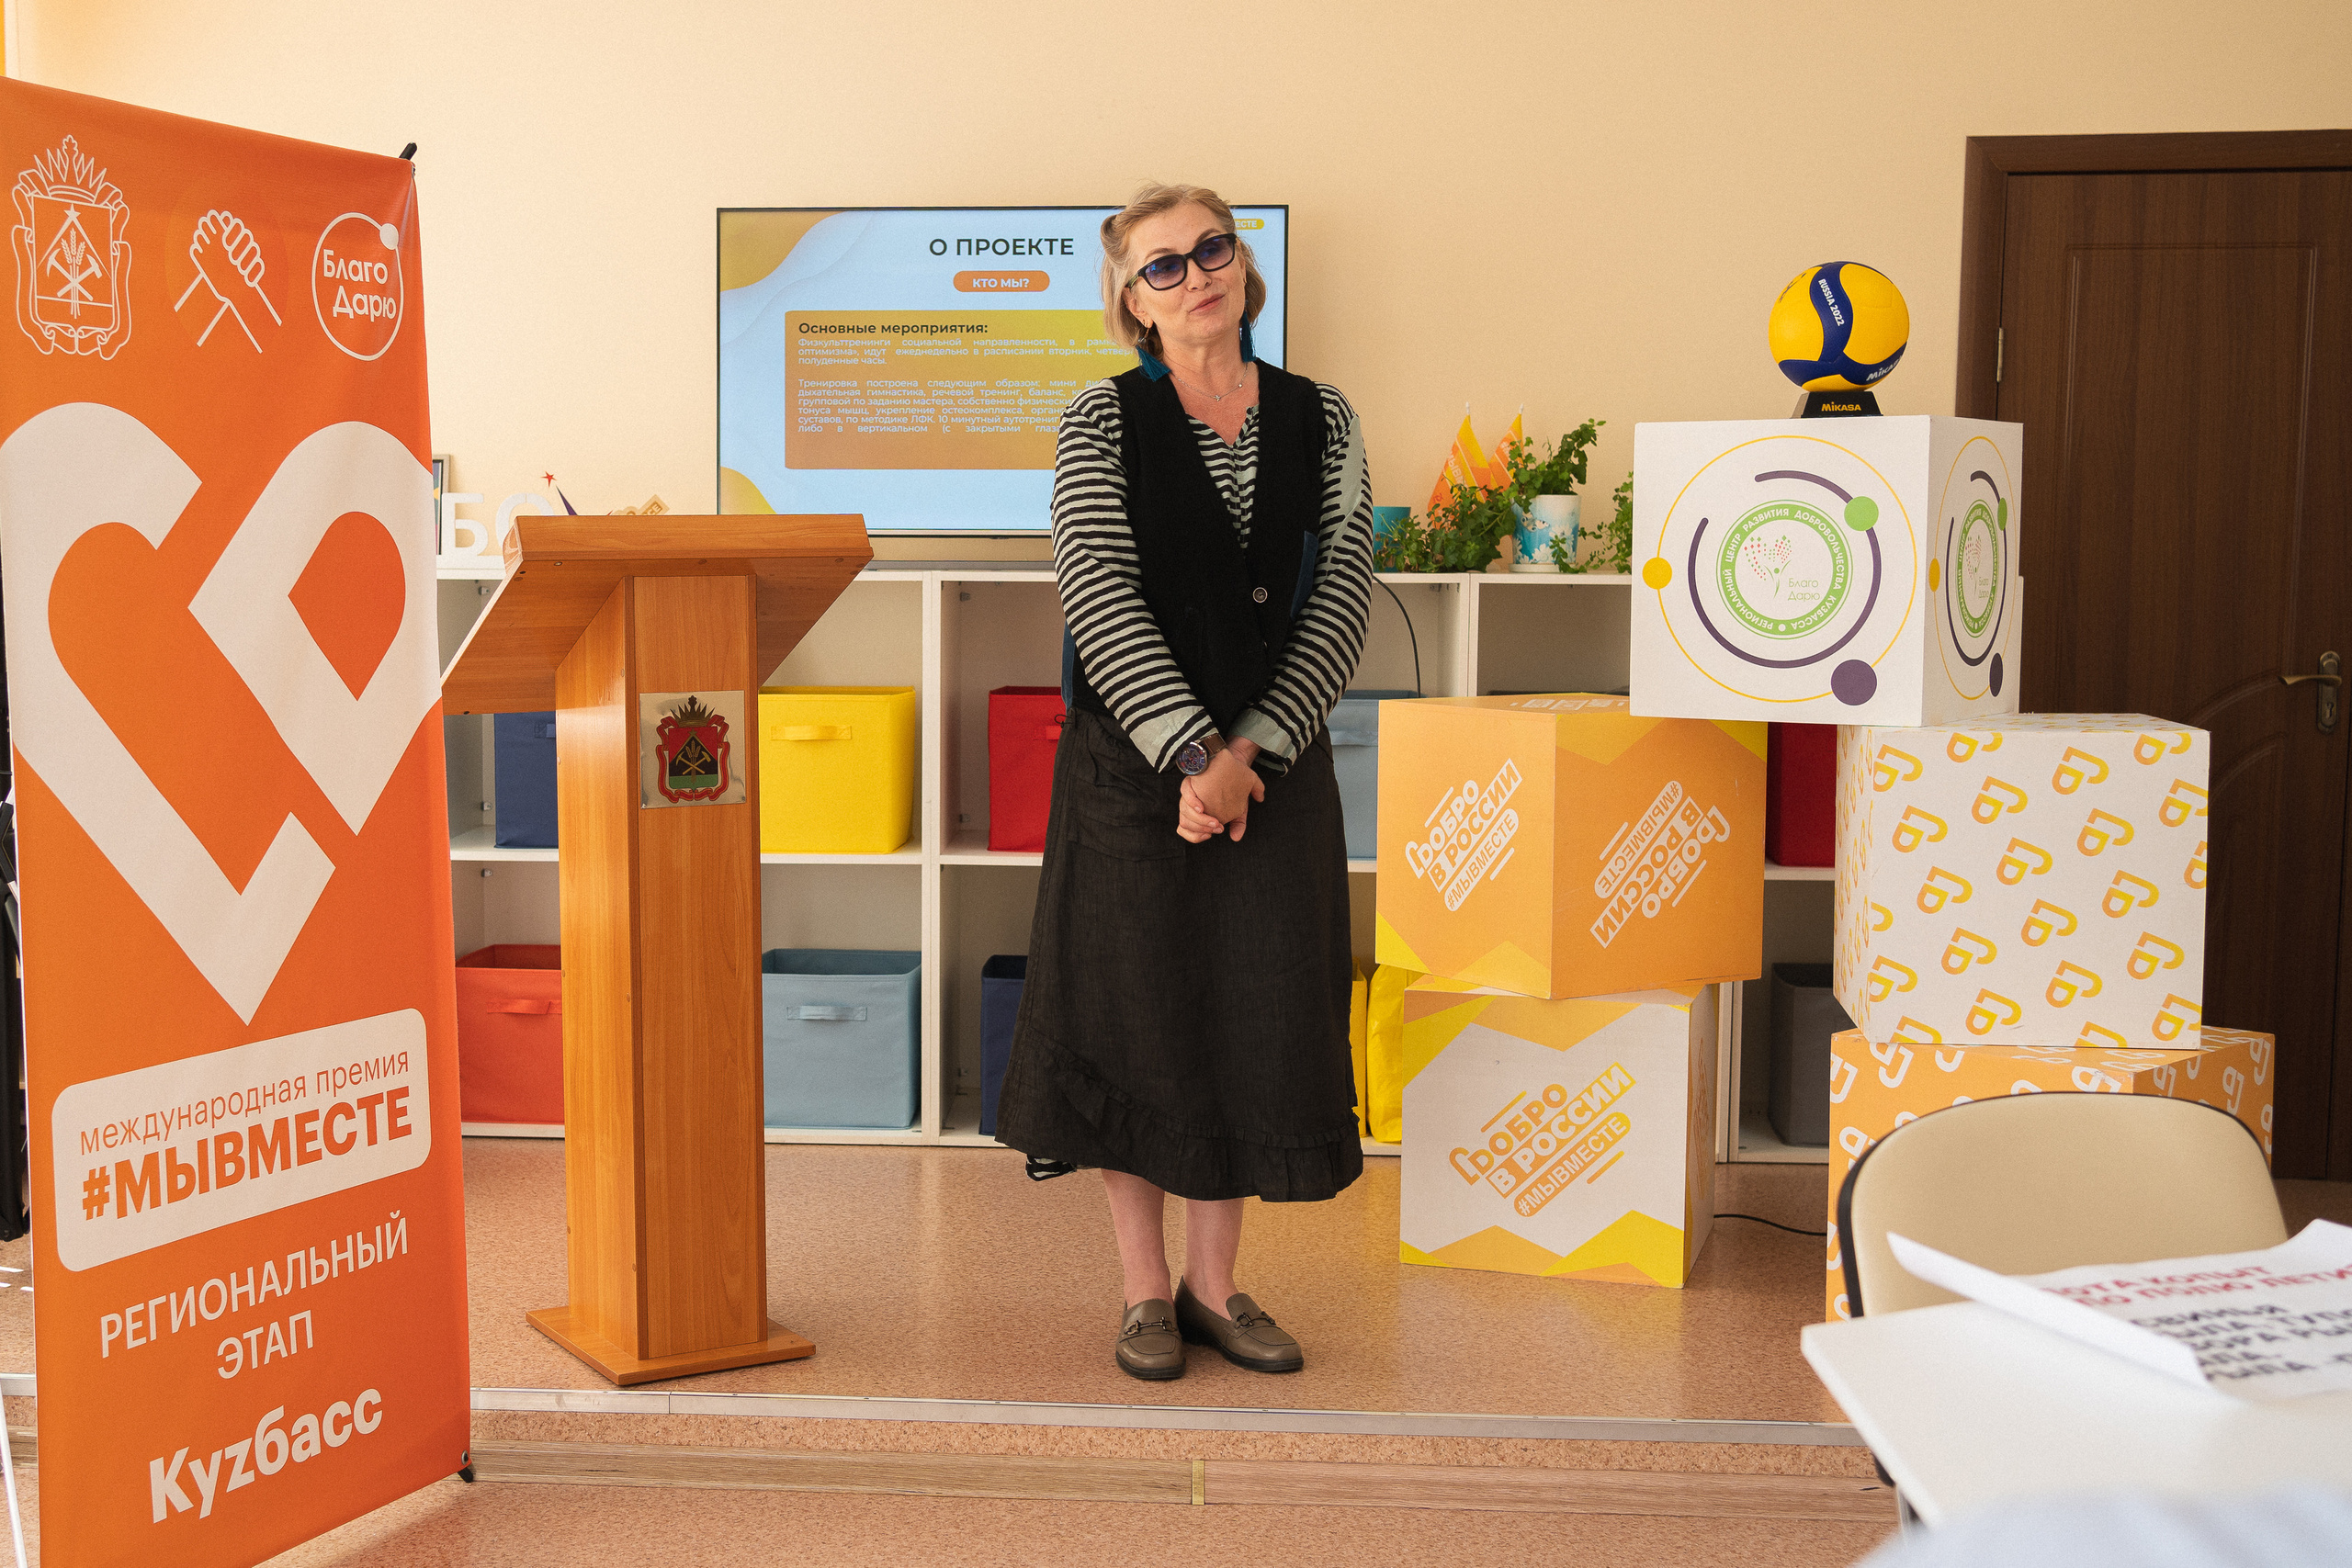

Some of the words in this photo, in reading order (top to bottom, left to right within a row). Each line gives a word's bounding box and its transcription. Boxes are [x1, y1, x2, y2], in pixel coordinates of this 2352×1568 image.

[930, 238, 947, 255] О
[956, 238, 1074, 255] ПРОЕКТЕ
[323, 249, 389, 285] Благо
[973, 278, 998, 288] КТО
[1001, 278, 1029, 288] МЫ?
[333, 285, 397, 323] Дарю
[1818, 278, 1836, 307] RUSSIA
[1830, 305, 1845, 326] 2022
[798, 322, 876, 333] Основные
[881, 324, 988, 336] мероприятия:
[902, 338, 962, 347] социальной
[973, 339, 1058, 347] направленности,
[798, 357, 859, 367] полуденные
[864, 348, 887, 356] идут
[984, 348, 1044, 356] расписании
[1048, 348, 1091, 356] вторник,
[798, 378, 858, 389] Тренировка
[866, 380, 919, 389] построена
[927, 379, 987, 389] следующим
[995, 378, 1040, 388] образом:
[1084, 379, 1101, 388] ди
[798, 389, 861, 397] дыхательная
[866, 389, 926, 397] гимнастика,
[932, 389, 974, 398] речевой
[980, 389, 1023, 398] тренинг,
[1028, 388, 1066, 397] баланс,
[798, 397, 851, 406] групповой
[913, 398, 956, 406] мастера,
[957, 397, 1014, 405] собственно
[1017, 397, 1071, 407] физически
[798, 424, 823, 433] либо
[857, 425, 928, 434] вертикальном
[966, 425, 1021, 434] закрытыми
[910, 415, 935, 423] ЛФК.
[938, 415, 948, 423] 10
[951, 415, 1001, 423] минутный
[1742, 508, 1789, 532] РАЗВИТИЯ
[1725, 533, 1742, 562] ЦЕНТР
[1793, 510, 1845, 590] ДОБРОВОЛЬЧЕСТВА
[1787, 591, 1820, 602] Дарю
[1788, 578, 1819, 588] Благо
[1723, 569, 1773, 630] РЕГИОНАЛЬНЫЙ
[1791, 594, 1837, 630] КУЗБАССА
[1429, 862, 1446, 887] В
[1444, 762, 1520, 868] РОССИИ
[1680, 801, 1701, 827] В
[1599, 783, 1679, 893] #МЫВМЕСТЕ
[1447, 814, 1516, 909] #МЫВМЕСТЕ
[1594, 825, 1683, 944] РОССИИ
[80, 1077, 308, 1156] международная
[316, 1050, 410, 1095] премия
[1488, 1168, 1516, 1195] В
[1512, 1066, 1632, 1174] РОССИИ
[83, 1086, 412, 1220] #МЫВМЕСТЕ
[1518, 1116, 1626, 1216] #МЫВМЕСТЕ
[100, 1210, 409, 1359] РЕГИОНАЛЬНЫЙ
[217, 1310, 314, 1380] ЭТАП
